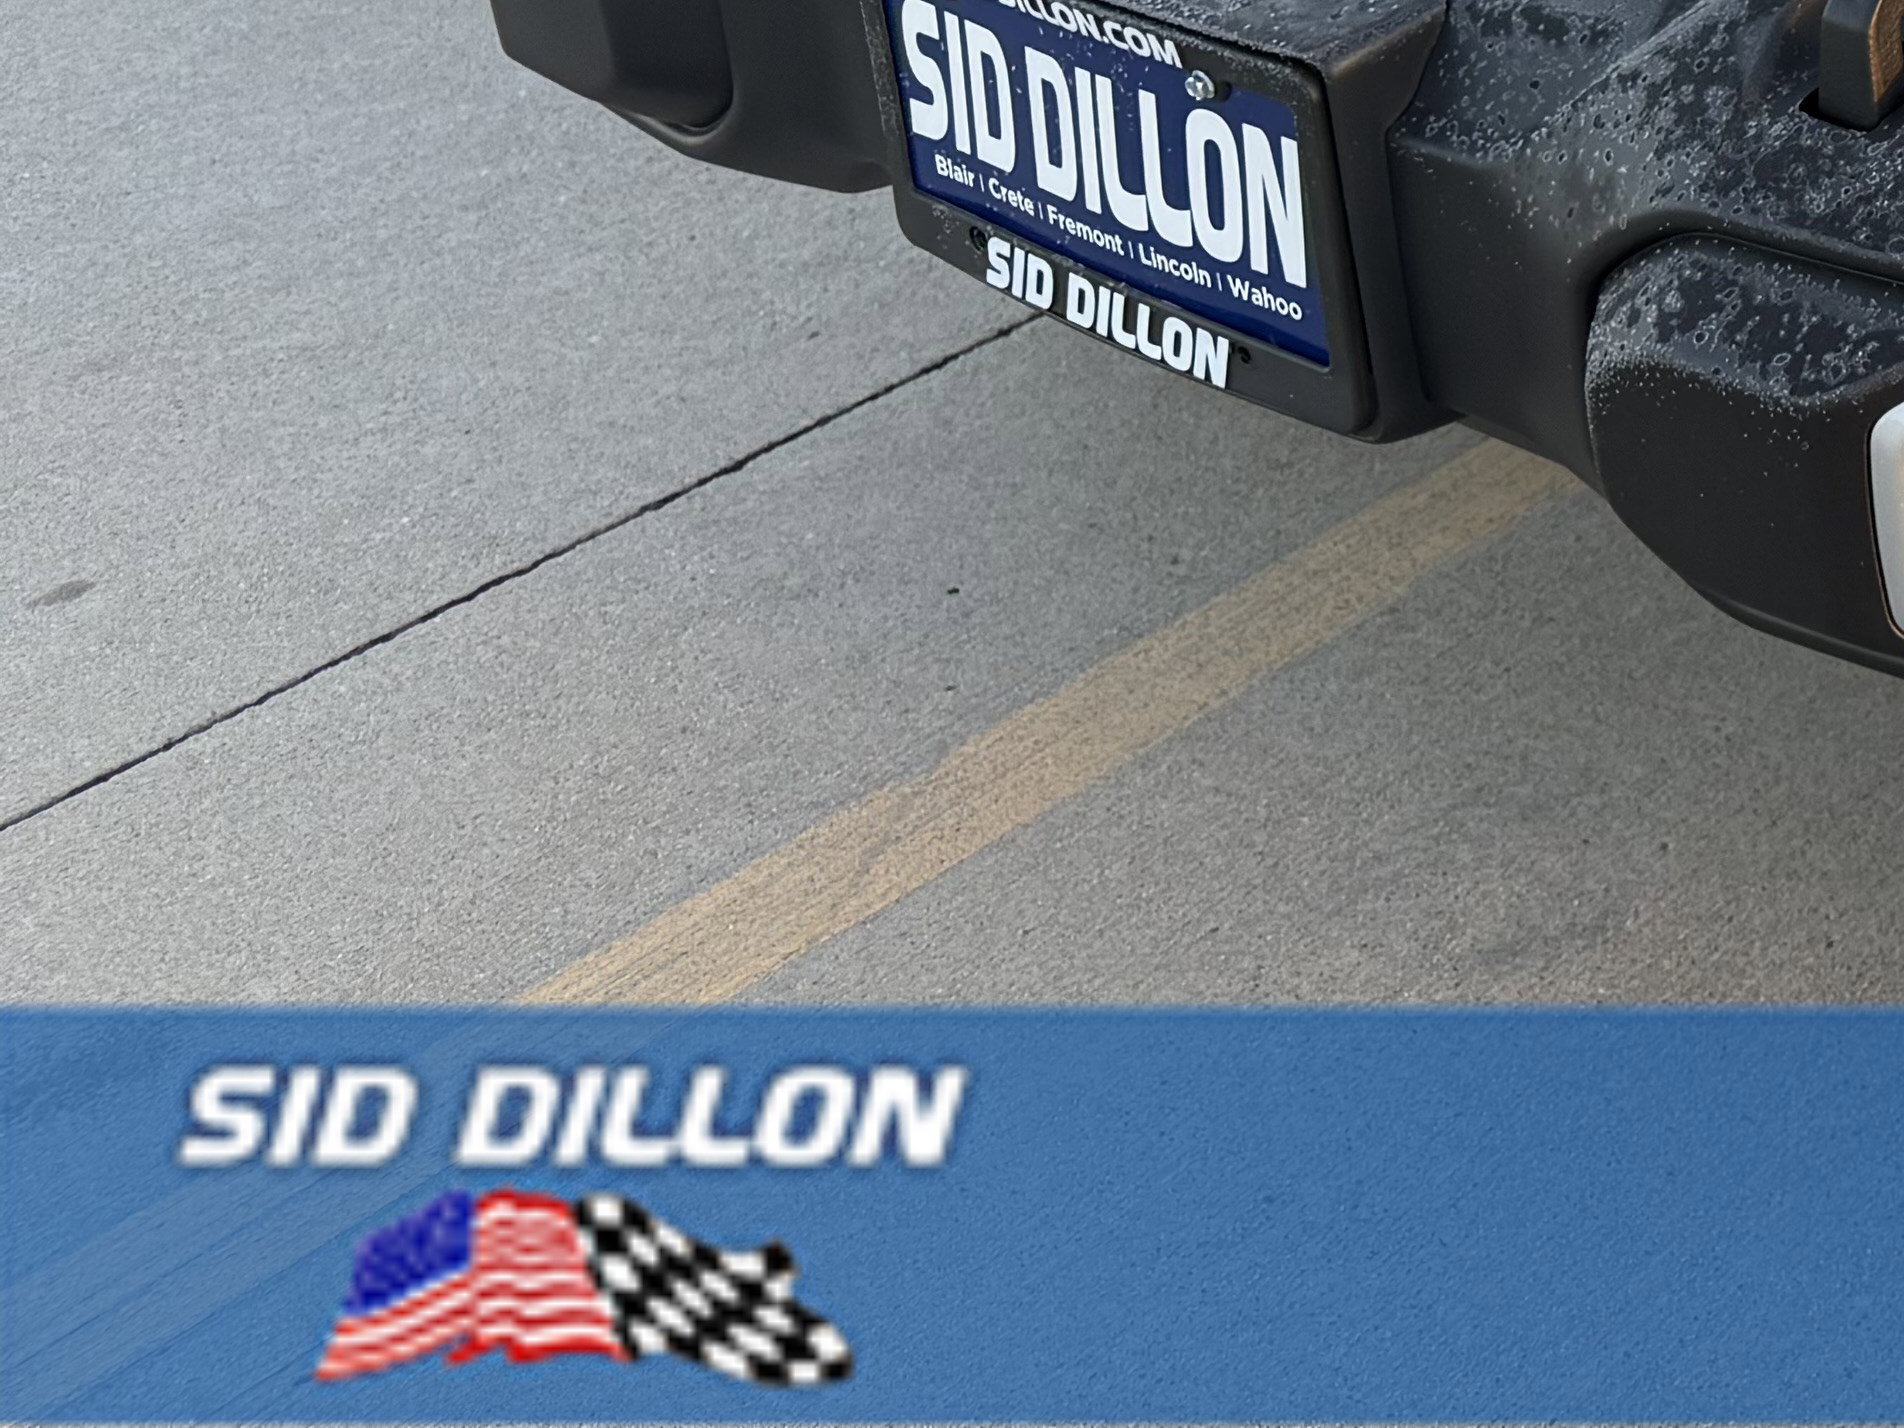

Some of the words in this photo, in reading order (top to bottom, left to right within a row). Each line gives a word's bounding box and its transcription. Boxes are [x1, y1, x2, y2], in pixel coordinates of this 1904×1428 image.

[935, 154, 976, 188] Blair
[988, 178, 1035, 217] Crete
[1047, 203, 1126, 257] Fremont
[1138, 244, 1212, 289] Lincoln
[1227, 273, 1304, 322] Wahoo
[1023, 44, 1308, 289] DILLON
[985, 235, 1055, 312] SID
[1065, 270, 1230, 390] DILLON
